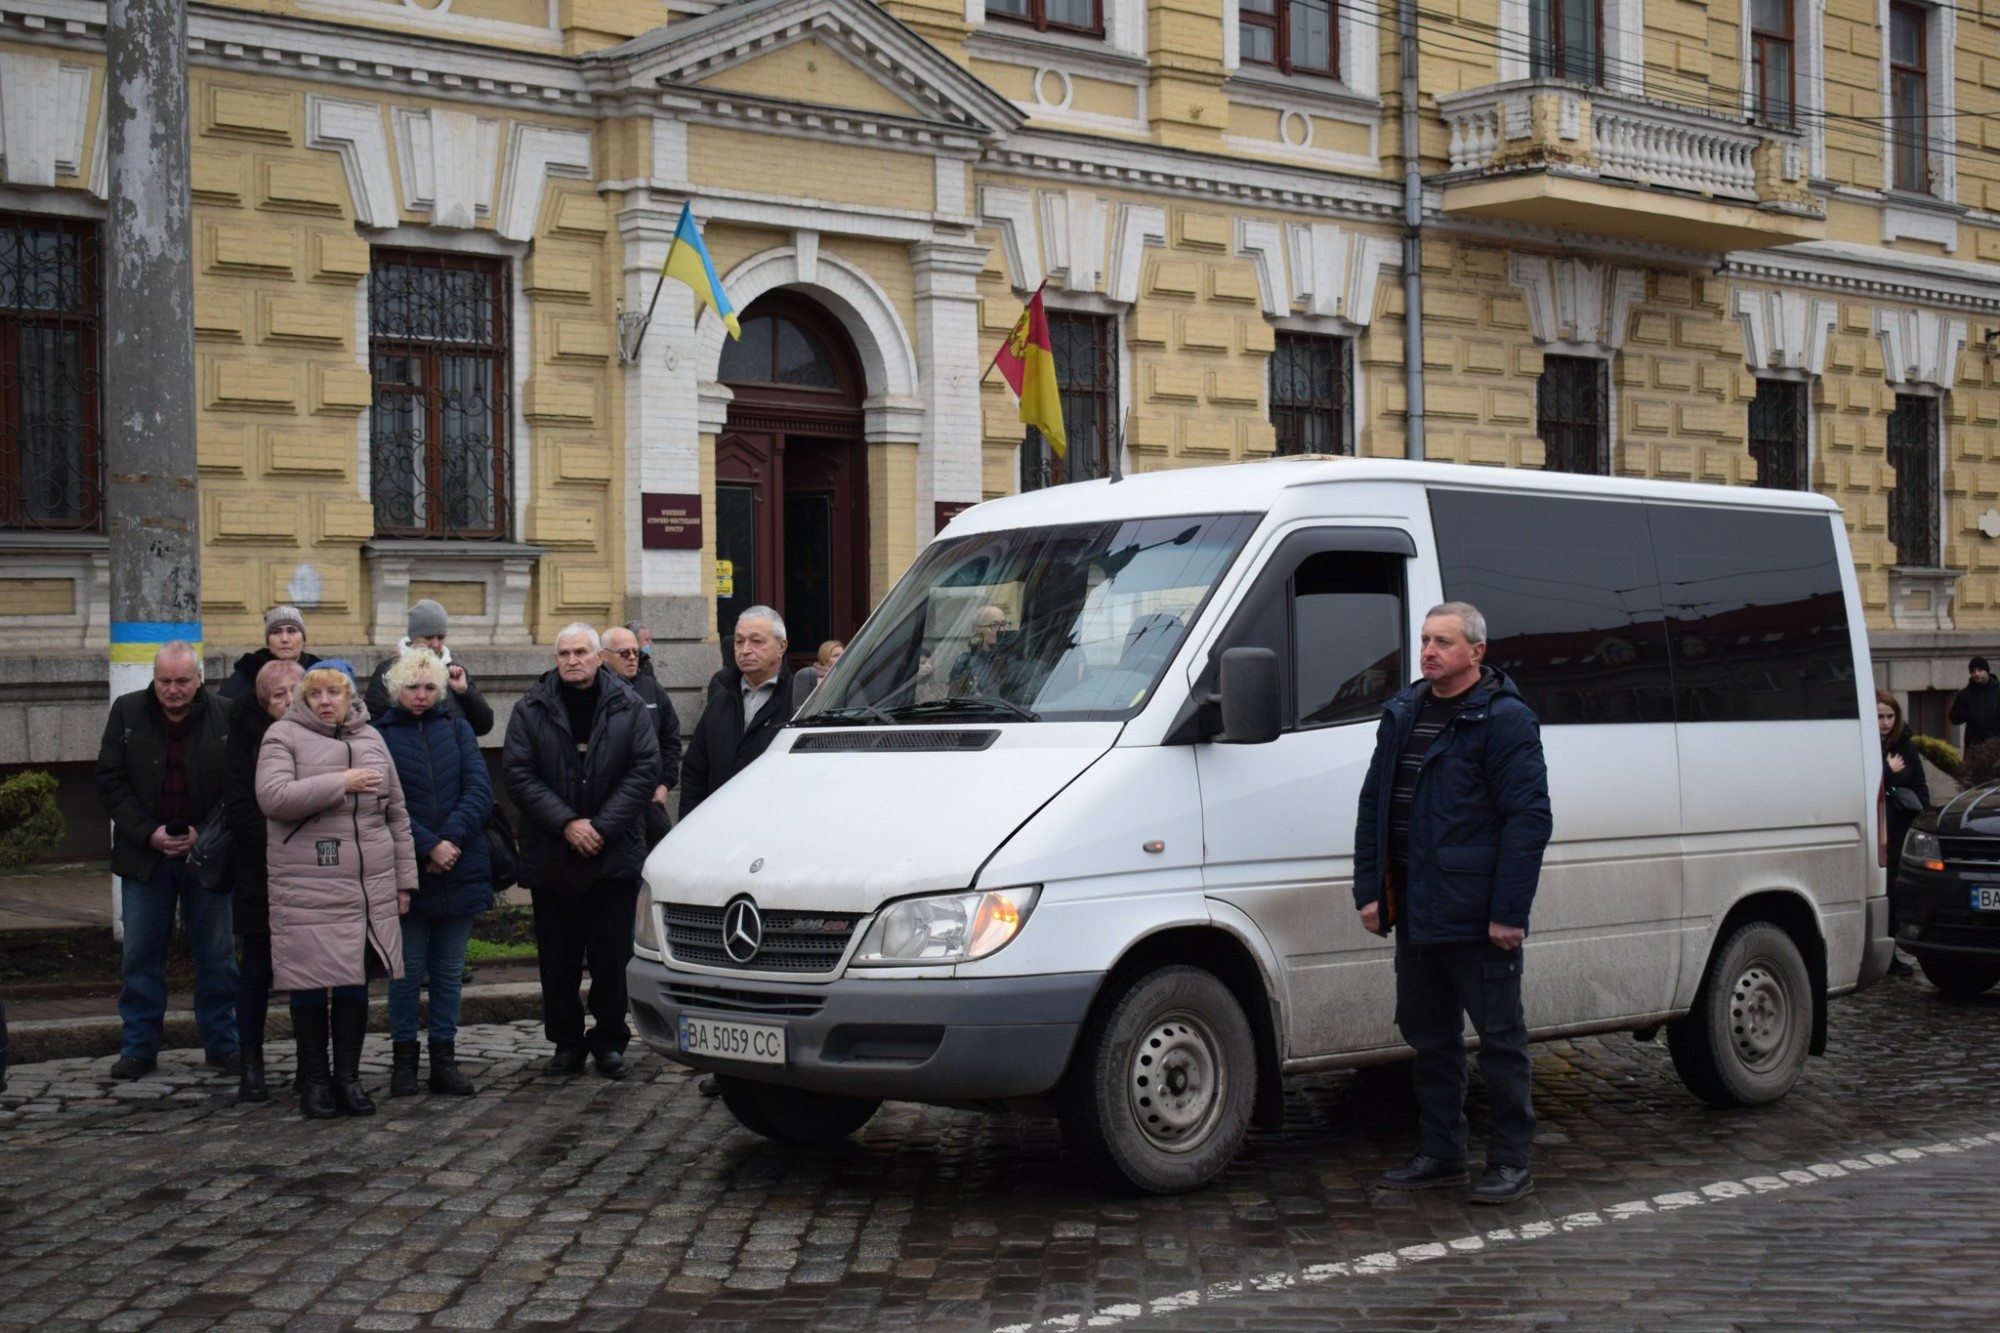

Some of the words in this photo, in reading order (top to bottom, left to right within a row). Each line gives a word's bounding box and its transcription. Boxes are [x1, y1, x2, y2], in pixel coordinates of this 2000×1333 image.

[688, 1023, 709, 1050] BA
[713, 1025, 749, 1054] 5059
[753, 1030, 778, 1057] CC
